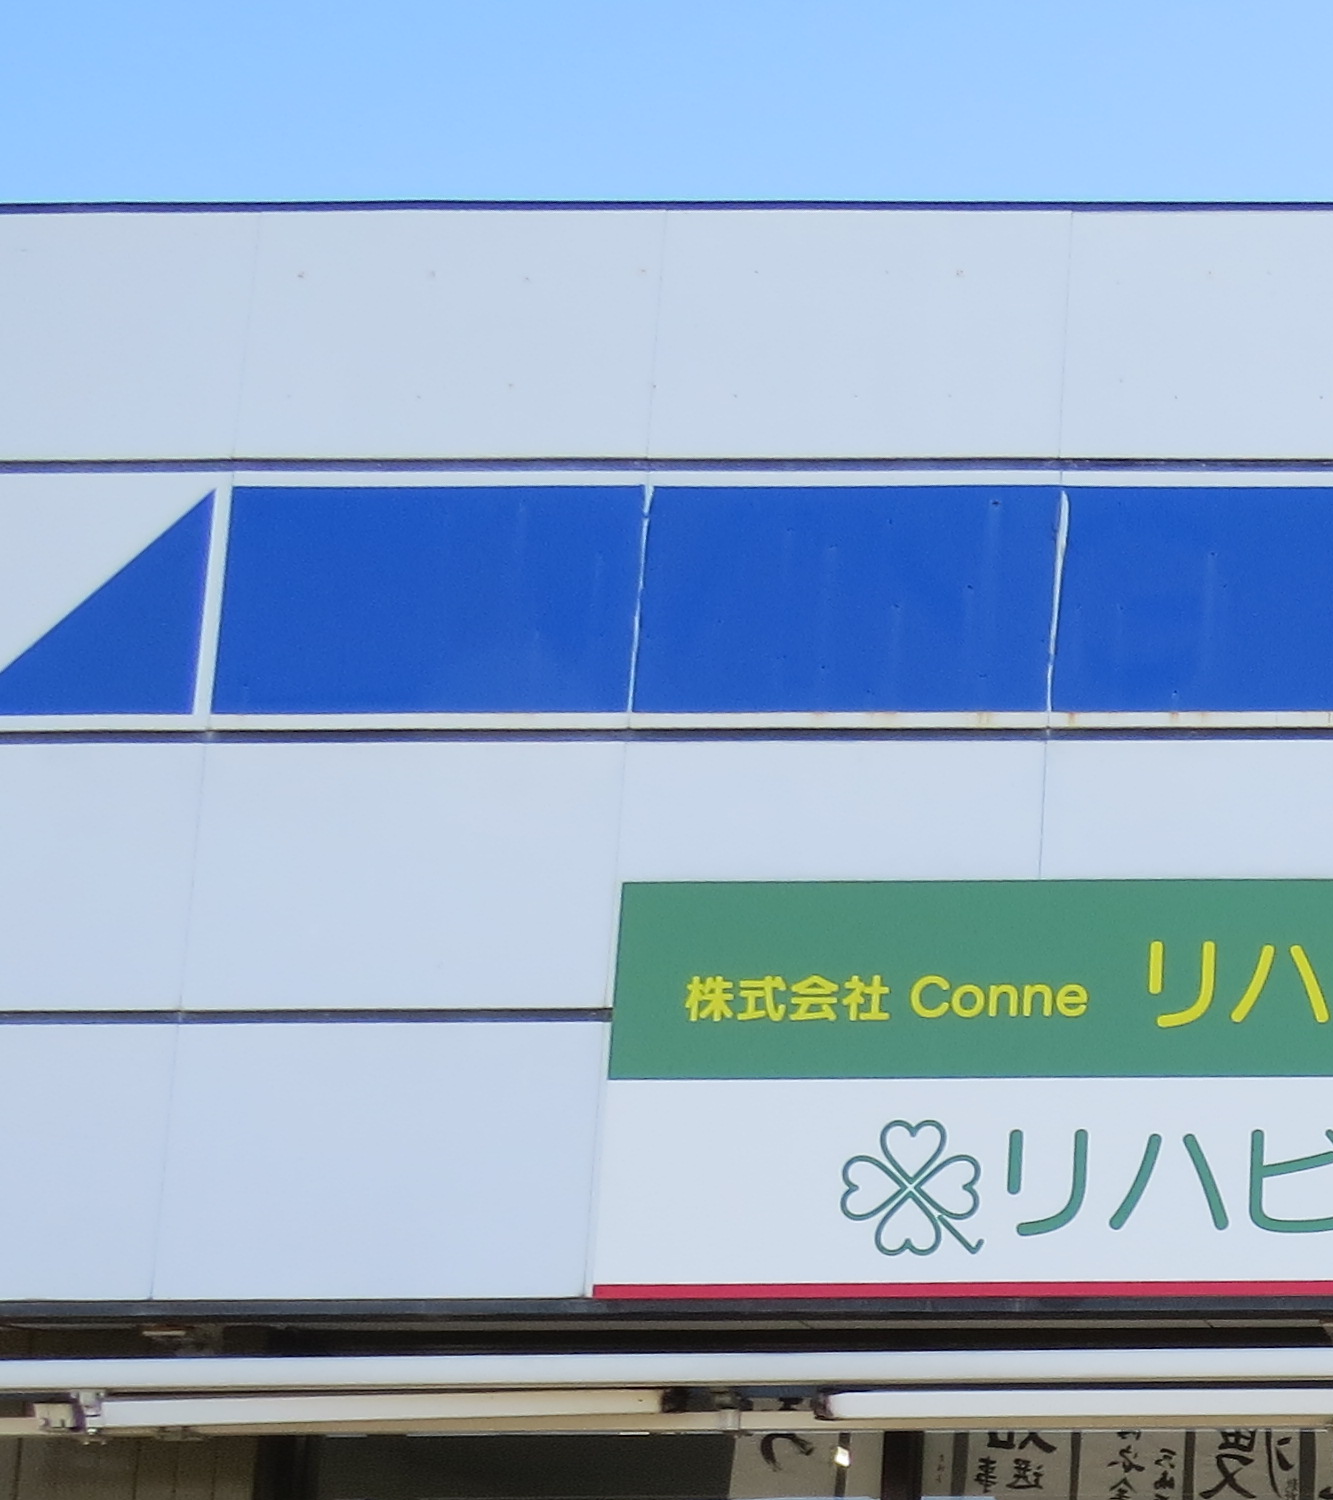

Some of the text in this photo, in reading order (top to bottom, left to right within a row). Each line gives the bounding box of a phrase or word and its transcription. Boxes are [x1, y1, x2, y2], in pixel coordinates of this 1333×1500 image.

[684, 974, 891, 1024] 株式会社
[910, 973, 1089, 1021] Conne
